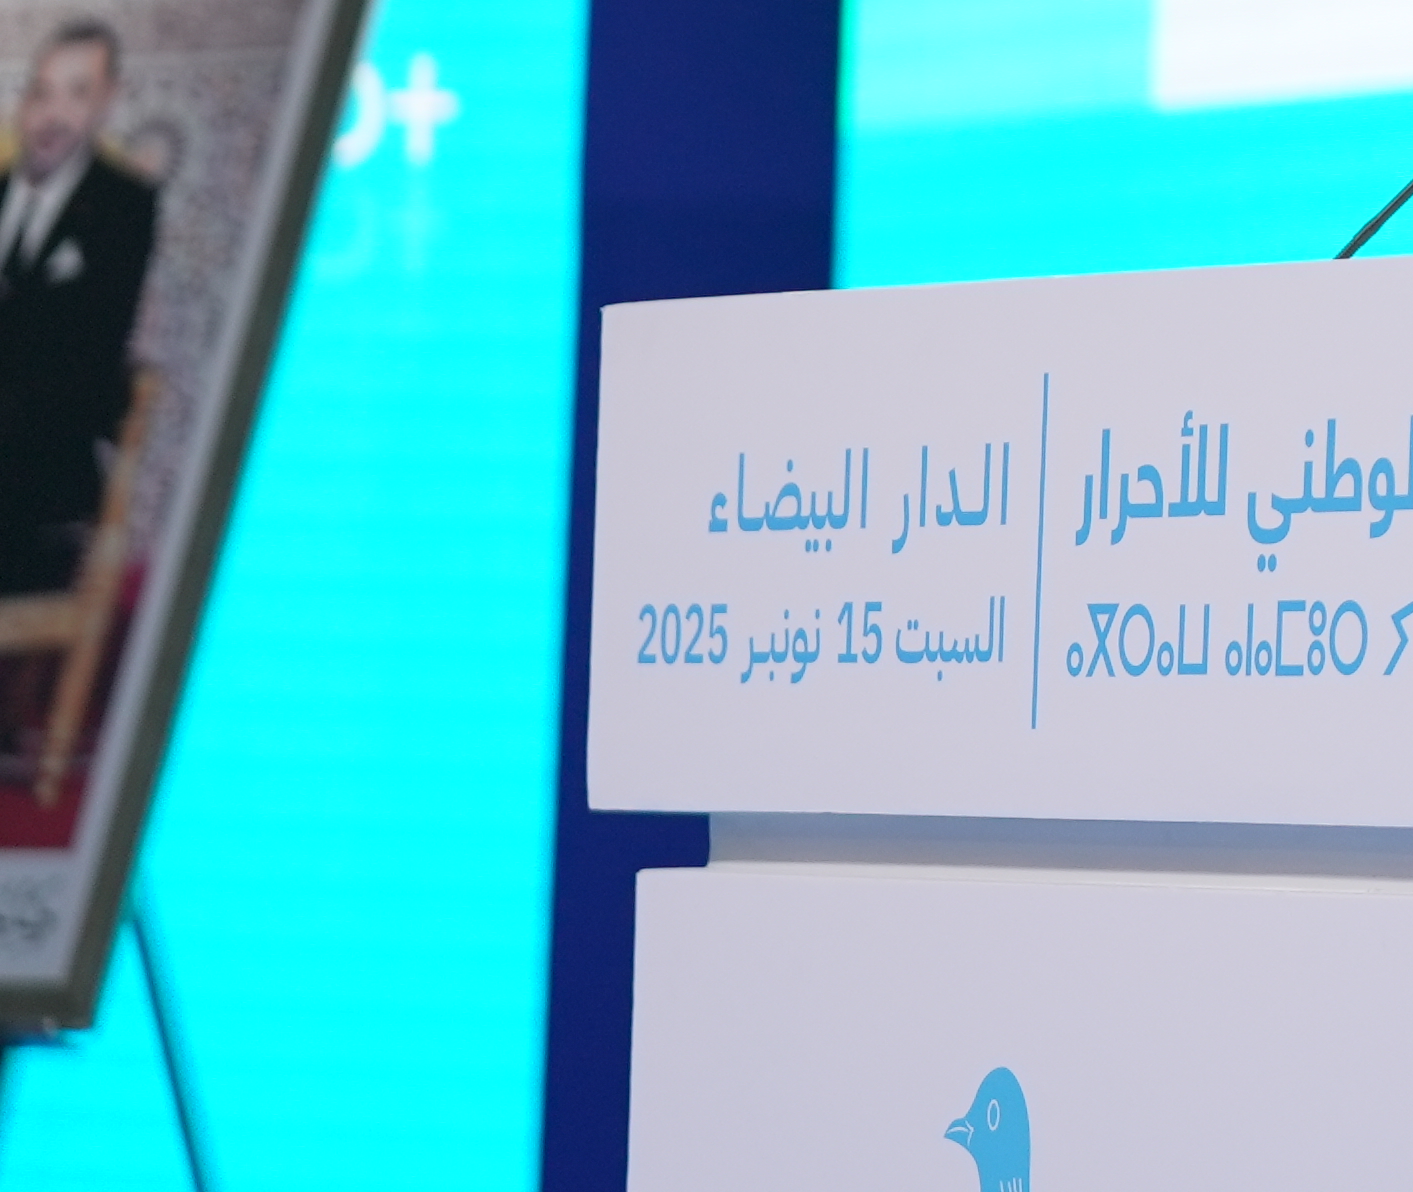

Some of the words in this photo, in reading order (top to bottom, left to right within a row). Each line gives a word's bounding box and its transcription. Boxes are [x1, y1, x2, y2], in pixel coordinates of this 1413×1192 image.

[708, 447, 869, 554] البيضاء
[891, 441, 1010, 555] الدار
[1075, 409, 1230, 547] للأحرار
[636, 603, 729, 666] 2025
[740, 608, 821, 685] نونبر
[837, 601, 883, 665] 15
[895, 595, 1006, 682] السبت
